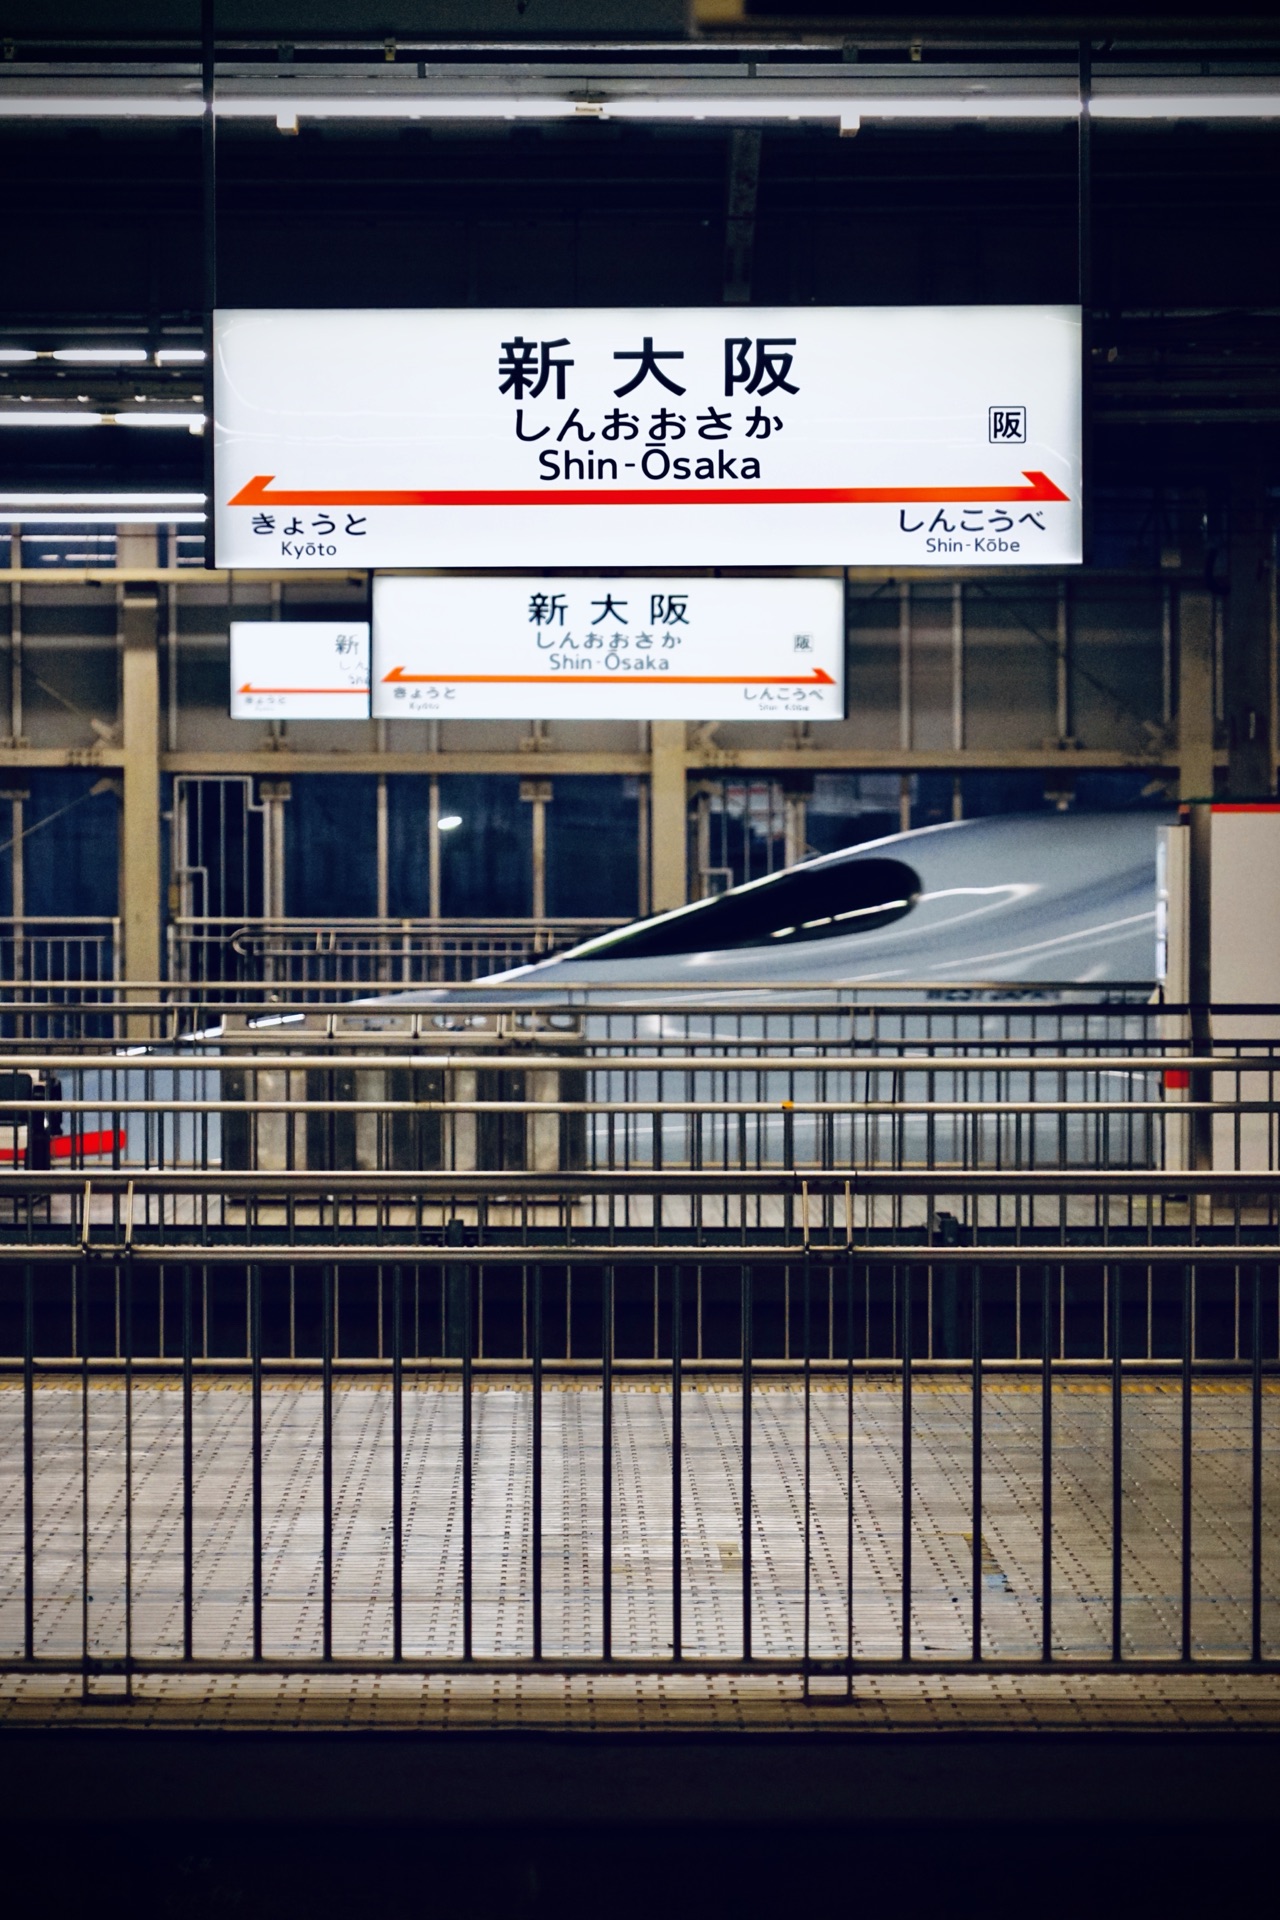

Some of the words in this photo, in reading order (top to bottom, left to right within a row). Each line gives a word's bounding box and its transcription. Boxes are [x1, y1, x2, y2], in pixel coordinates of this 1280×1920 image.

[498, 336, 801, 400] 新大阪
[515, 405, 784, 442] しんおおさか
[993, 411, 1023, 439] 阪
[538, 443, 761, 481] Shin-Ōsaka
[251, 512, 367, 536] きょうと
[899, 508, 1046, 533] しんこうべ
[281, 541, 337, 560] Kyōto
[926, 537, 1020, 553] Shin-Kōbe
[528, 592, 690, 626] 新大阪
[536, 631, 682, 650] しんおおさか
[549, 649, 670, 671] Shin-Ōsaka
[393, 687, 456, 699] きょうと
[743, 687, 824, 701] しんこうべ
